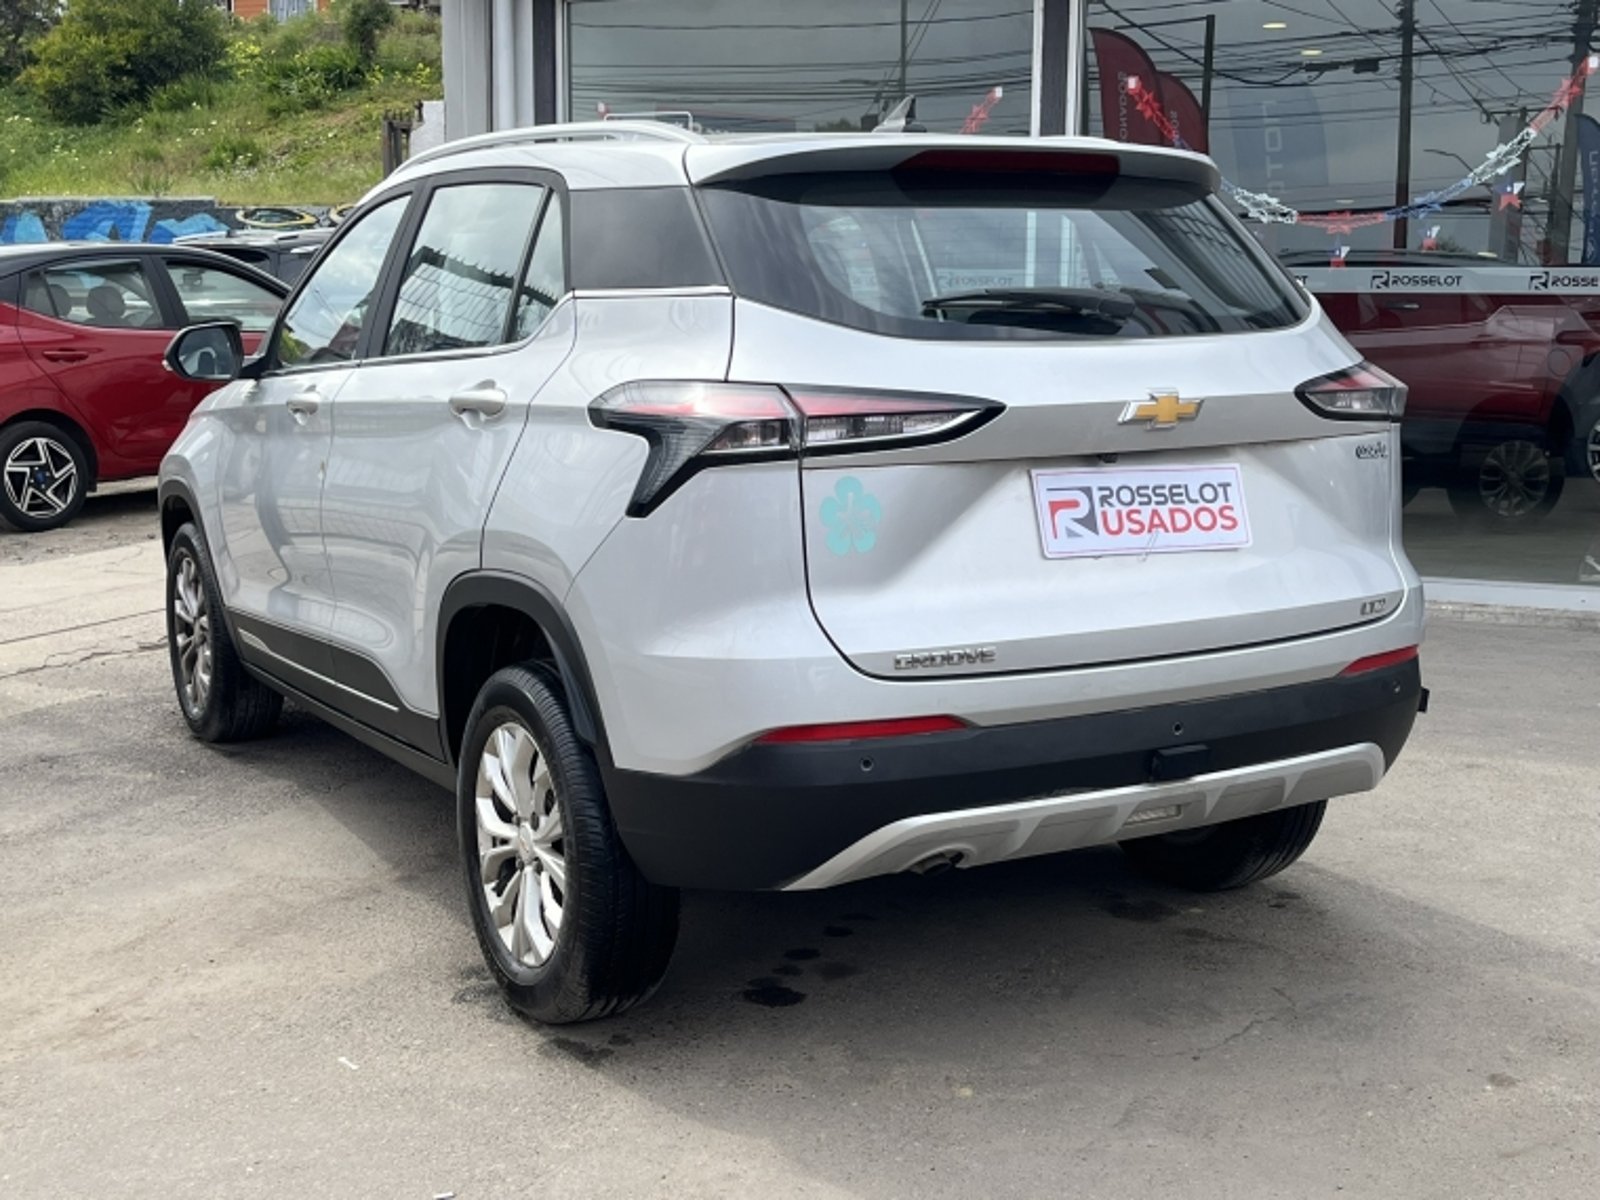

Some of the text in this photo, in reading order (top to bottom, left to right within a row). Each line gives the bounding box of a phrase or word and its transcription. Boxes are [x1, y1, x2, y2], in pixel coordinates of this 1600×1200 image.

[1391, 275, 1463, 287] ROSSELOT
[1098, 482, 1232, 506] ROSSELOT
[1102, 504, 1238, 535] USADOS
[894, 646, 996, 670] GROOVE
